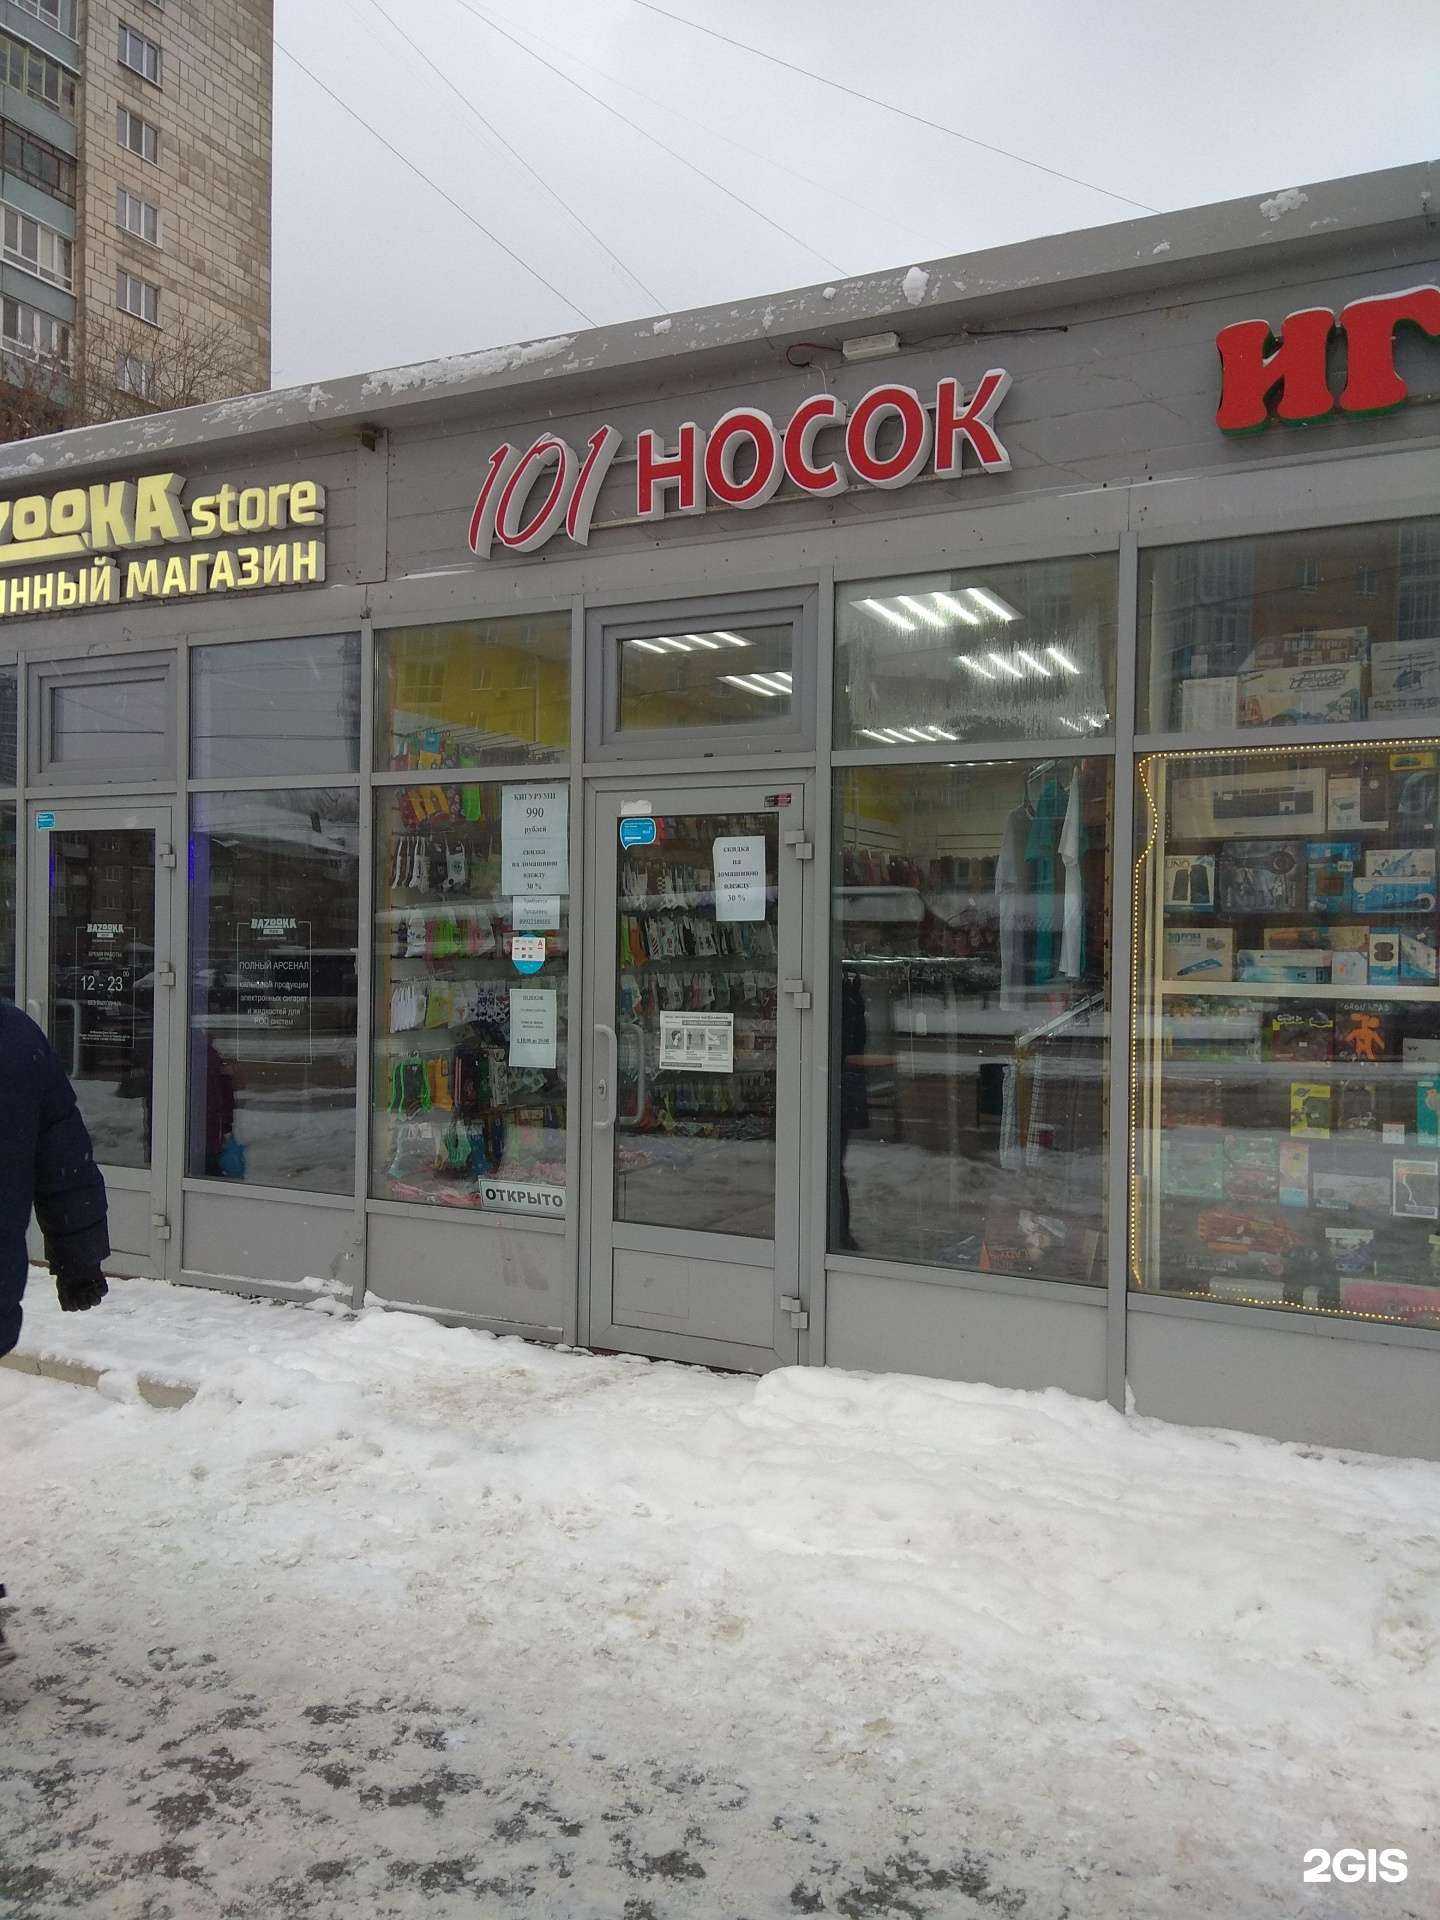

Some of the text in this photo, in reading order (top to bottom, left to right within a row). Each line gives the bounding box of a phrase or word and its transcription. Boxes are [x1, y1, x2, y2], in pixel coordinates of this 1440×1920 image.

[468, 367, 1013, 560] 101 НОСОК
[191, 480, 324, 540] store
[126, 540, 325, 600] МАГАЗИН
[526, 807, 544, 818] 990
[250, 918, 298, 930] BAZOOKA
[239, 960, 310, 971] ПОЛНЫЙ АРСЕНАЛ
[80, 975, 95, 991] 12
[107, 976, 123, 992] 23
[485, 1188, 564, 1208] ОТКРЫТО
